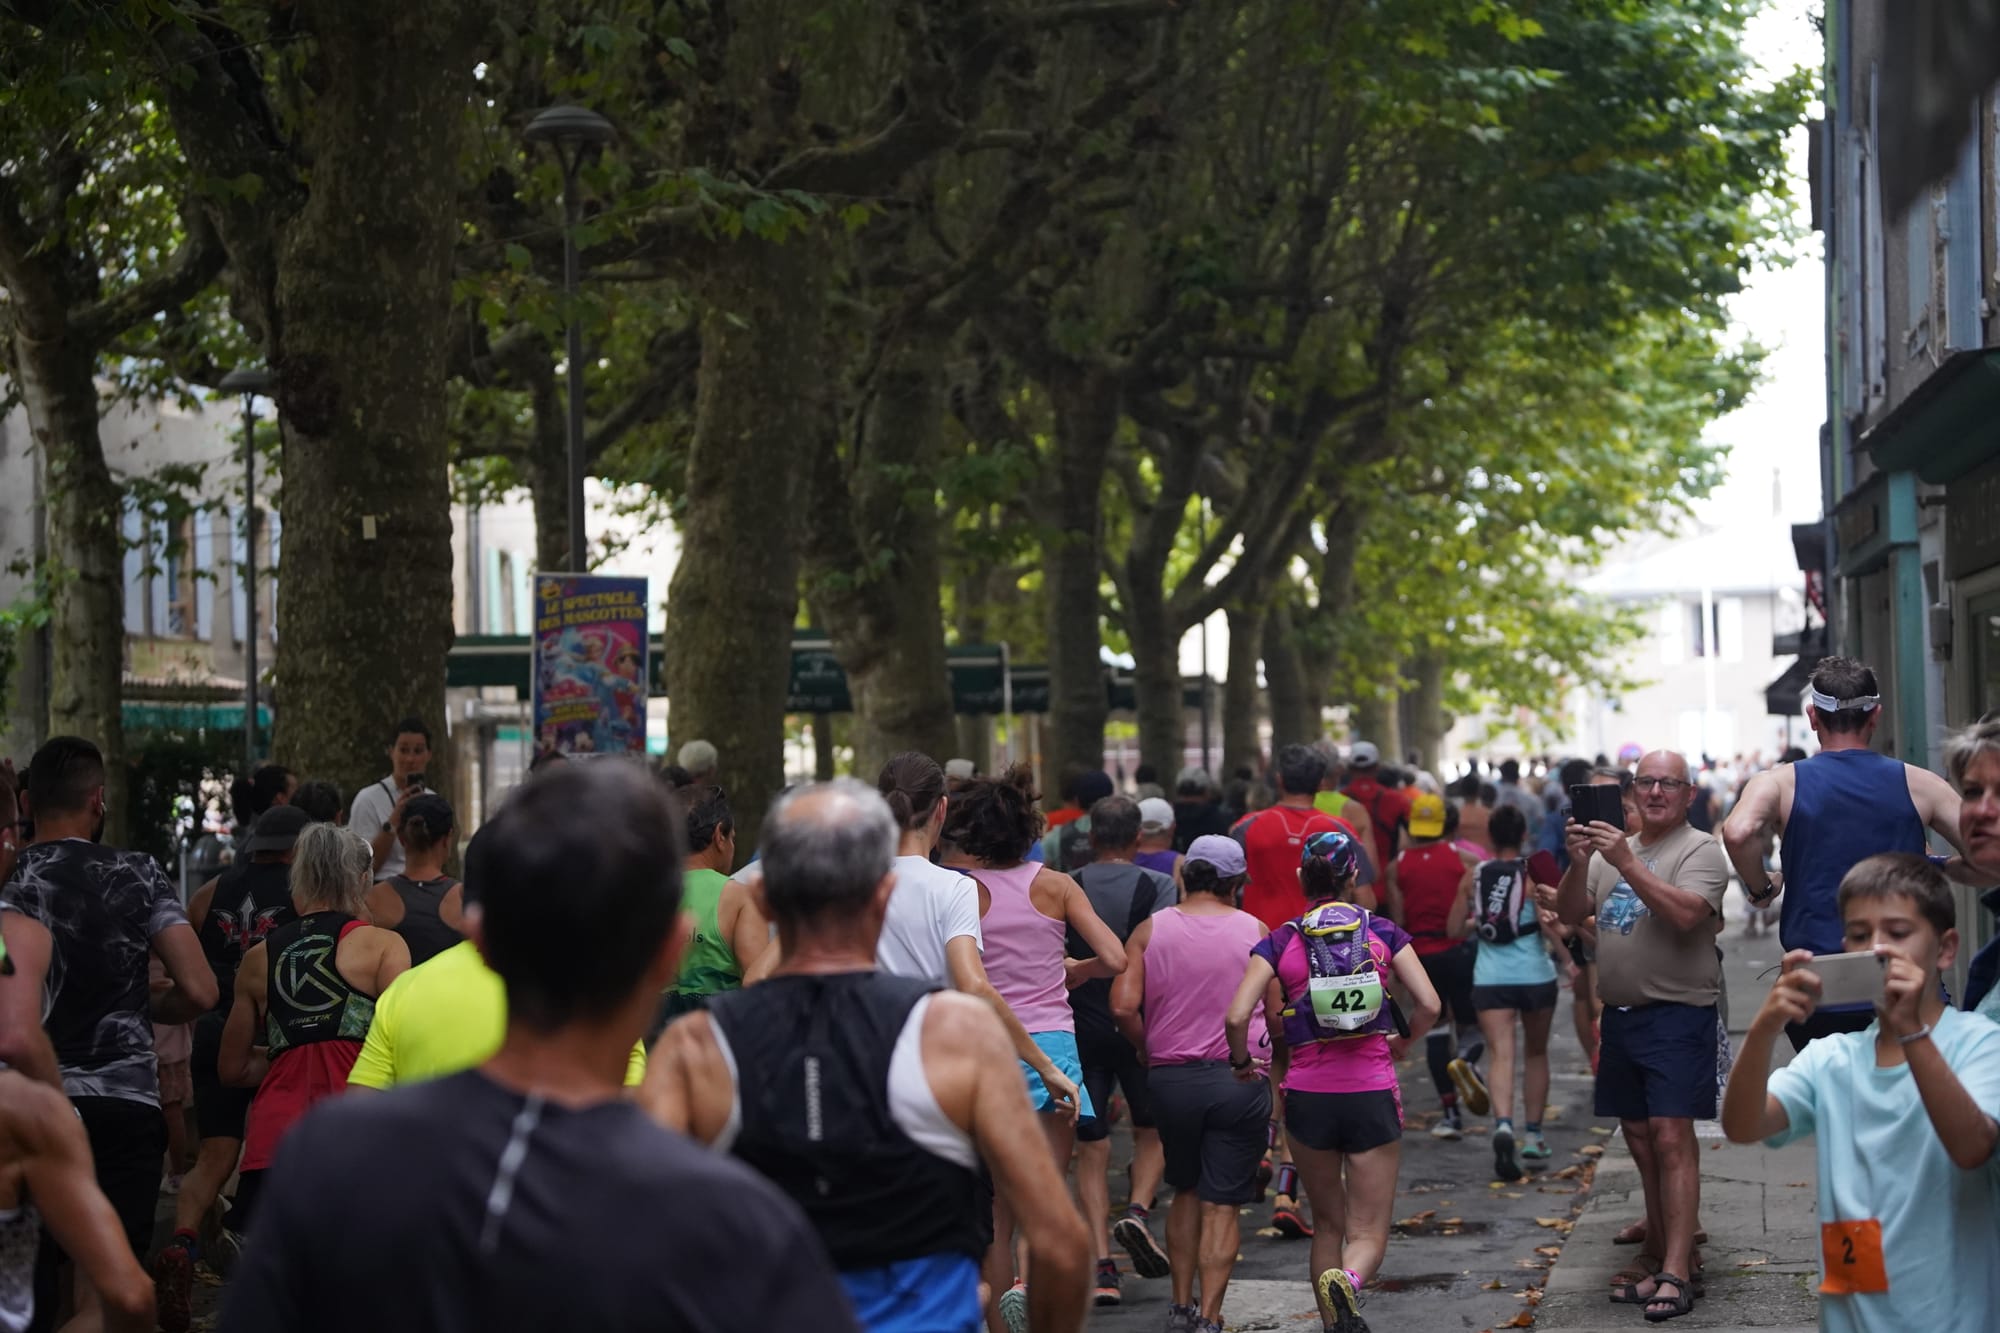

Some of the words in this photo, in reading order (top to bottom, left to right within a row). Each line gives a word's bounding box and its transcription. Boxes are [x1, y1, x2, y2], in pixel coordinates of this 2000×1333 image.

[545, 600, 560, 615] LE
[563, 592, 637, 611] SPECTACLE
[538, 616, 561, 632] DES
[563, 606, 645, 626] MASCOTTES
[1331, 990, 1366, 1013] 42
[1842, 1235, 1857, 1265] 2
